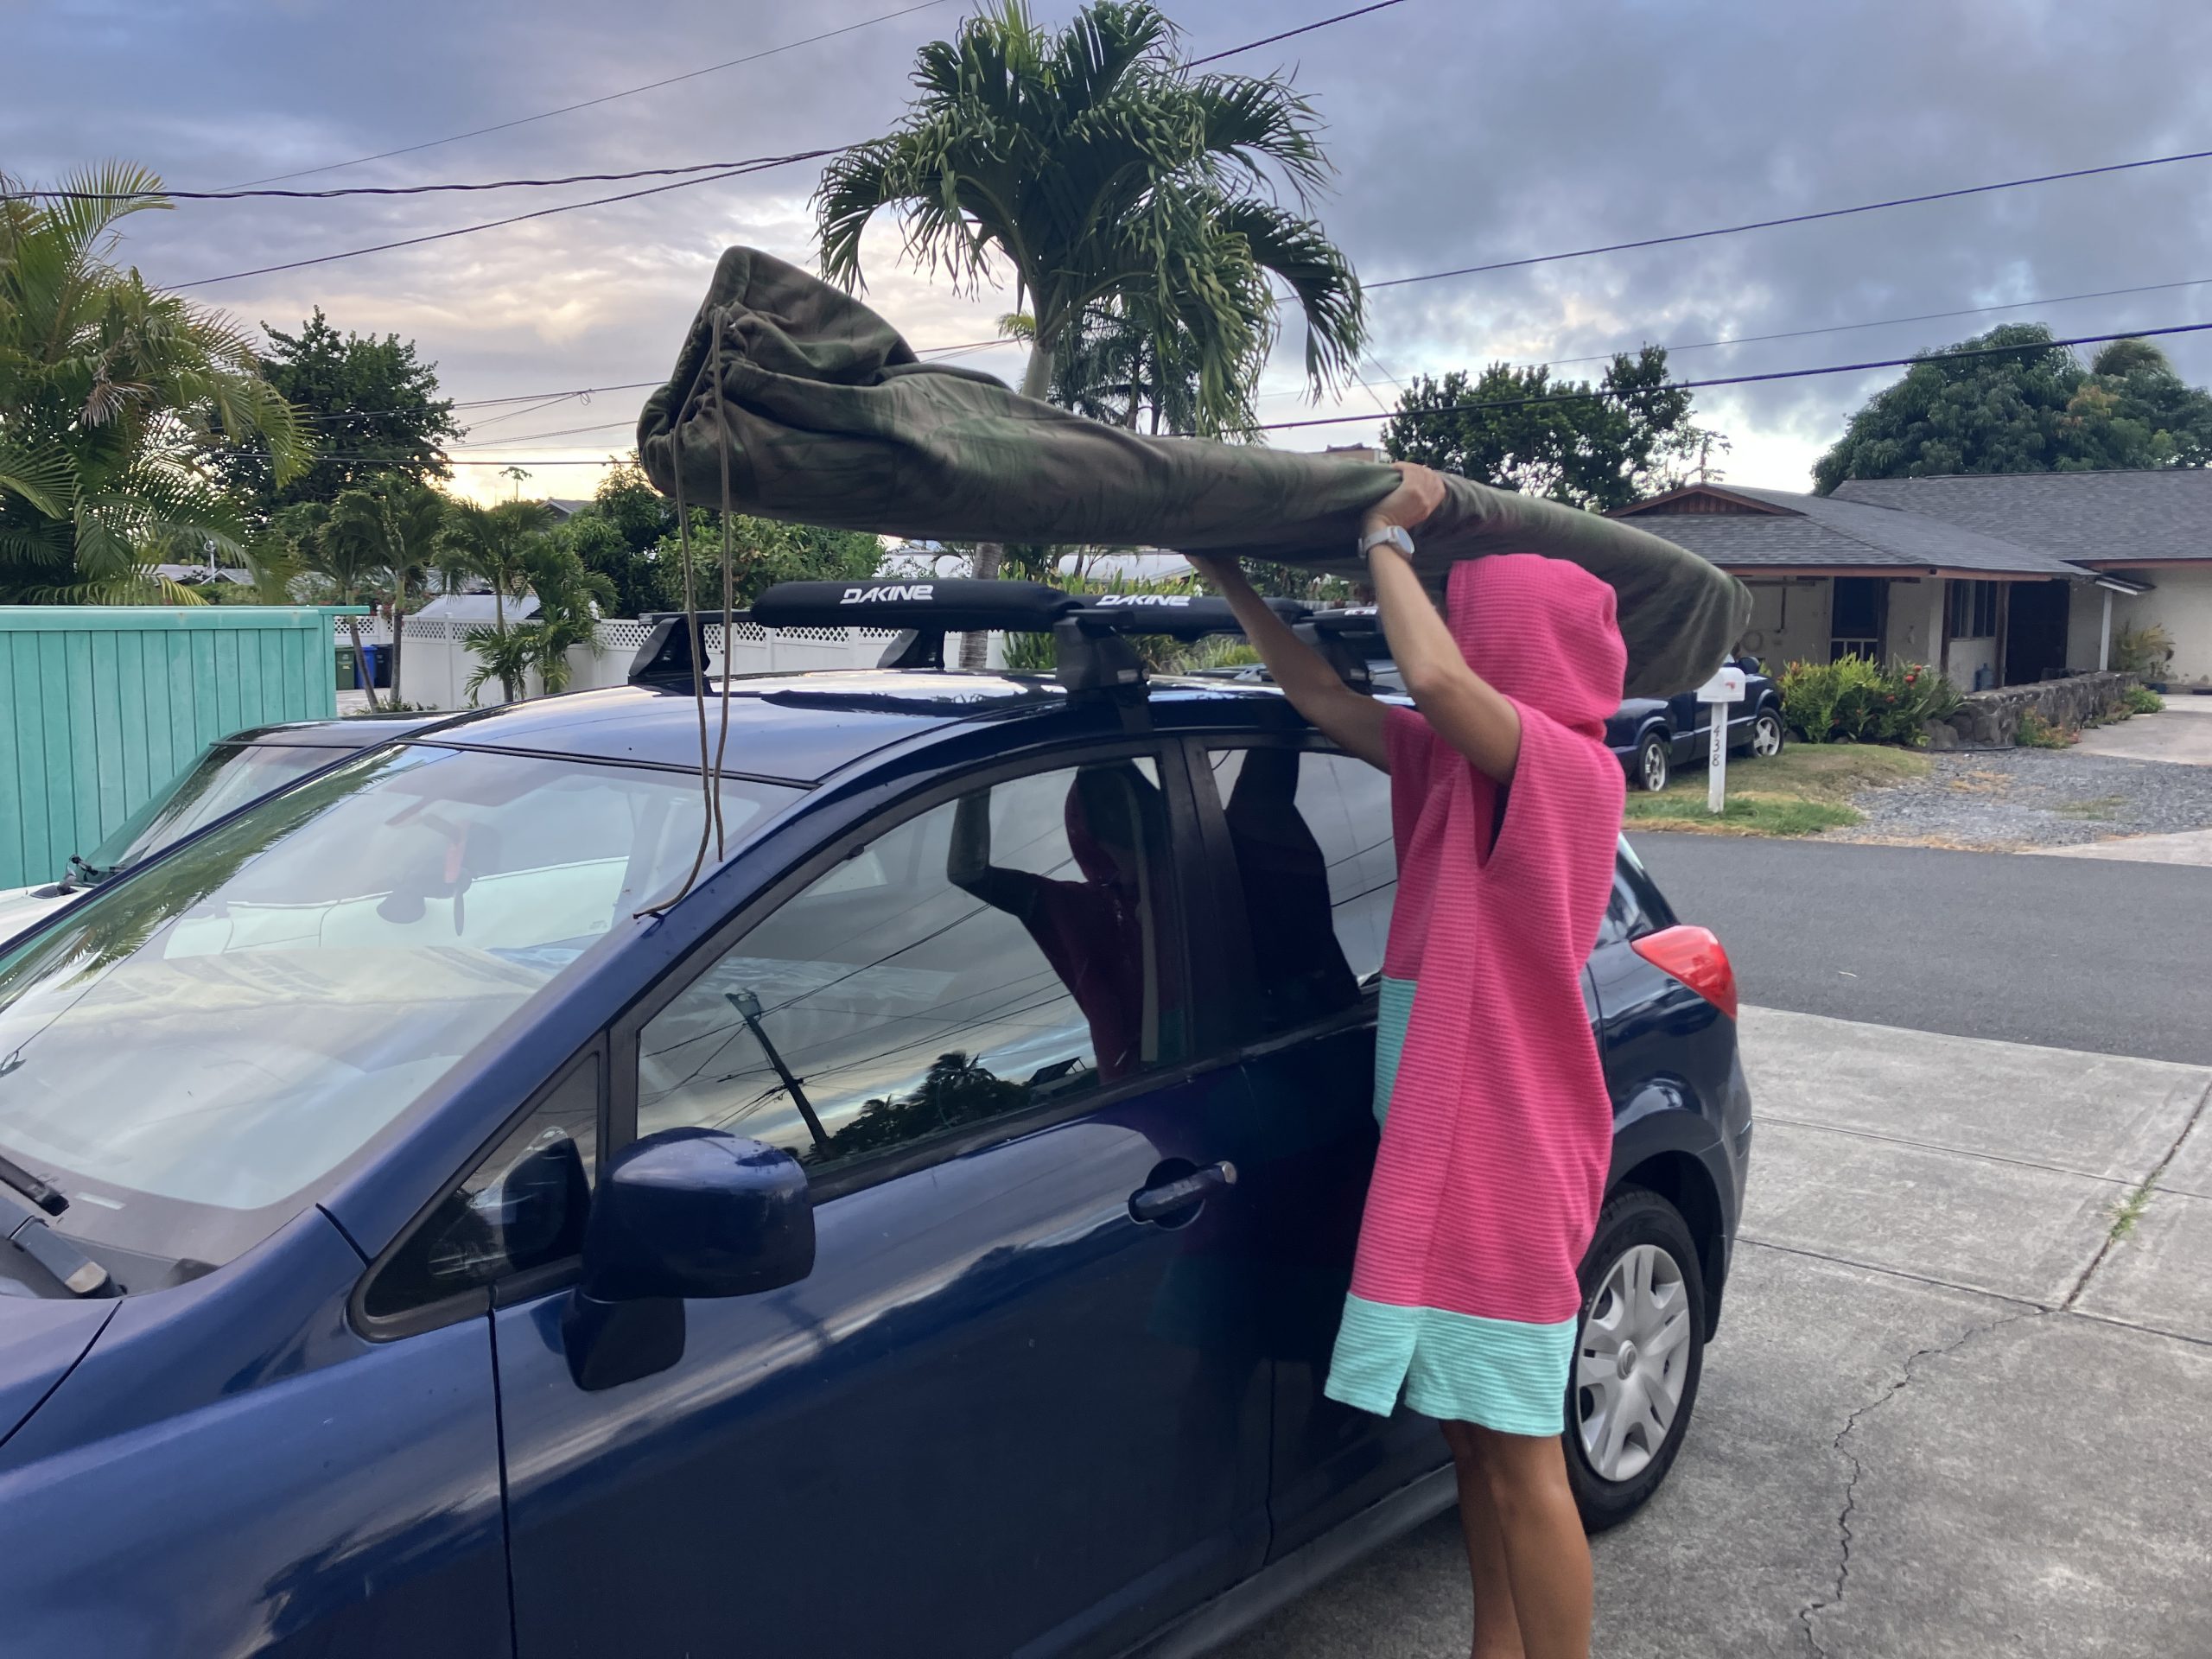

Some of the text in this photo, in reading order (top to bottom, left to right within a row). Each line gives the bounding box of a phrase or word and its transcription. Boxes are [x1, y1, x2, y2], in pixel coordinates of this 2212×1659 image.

[840, 585, 934, 604] DAKINE
[1096, 594, 1191, 606] DAKINE
[1712, 725, 1721, 766] 438
